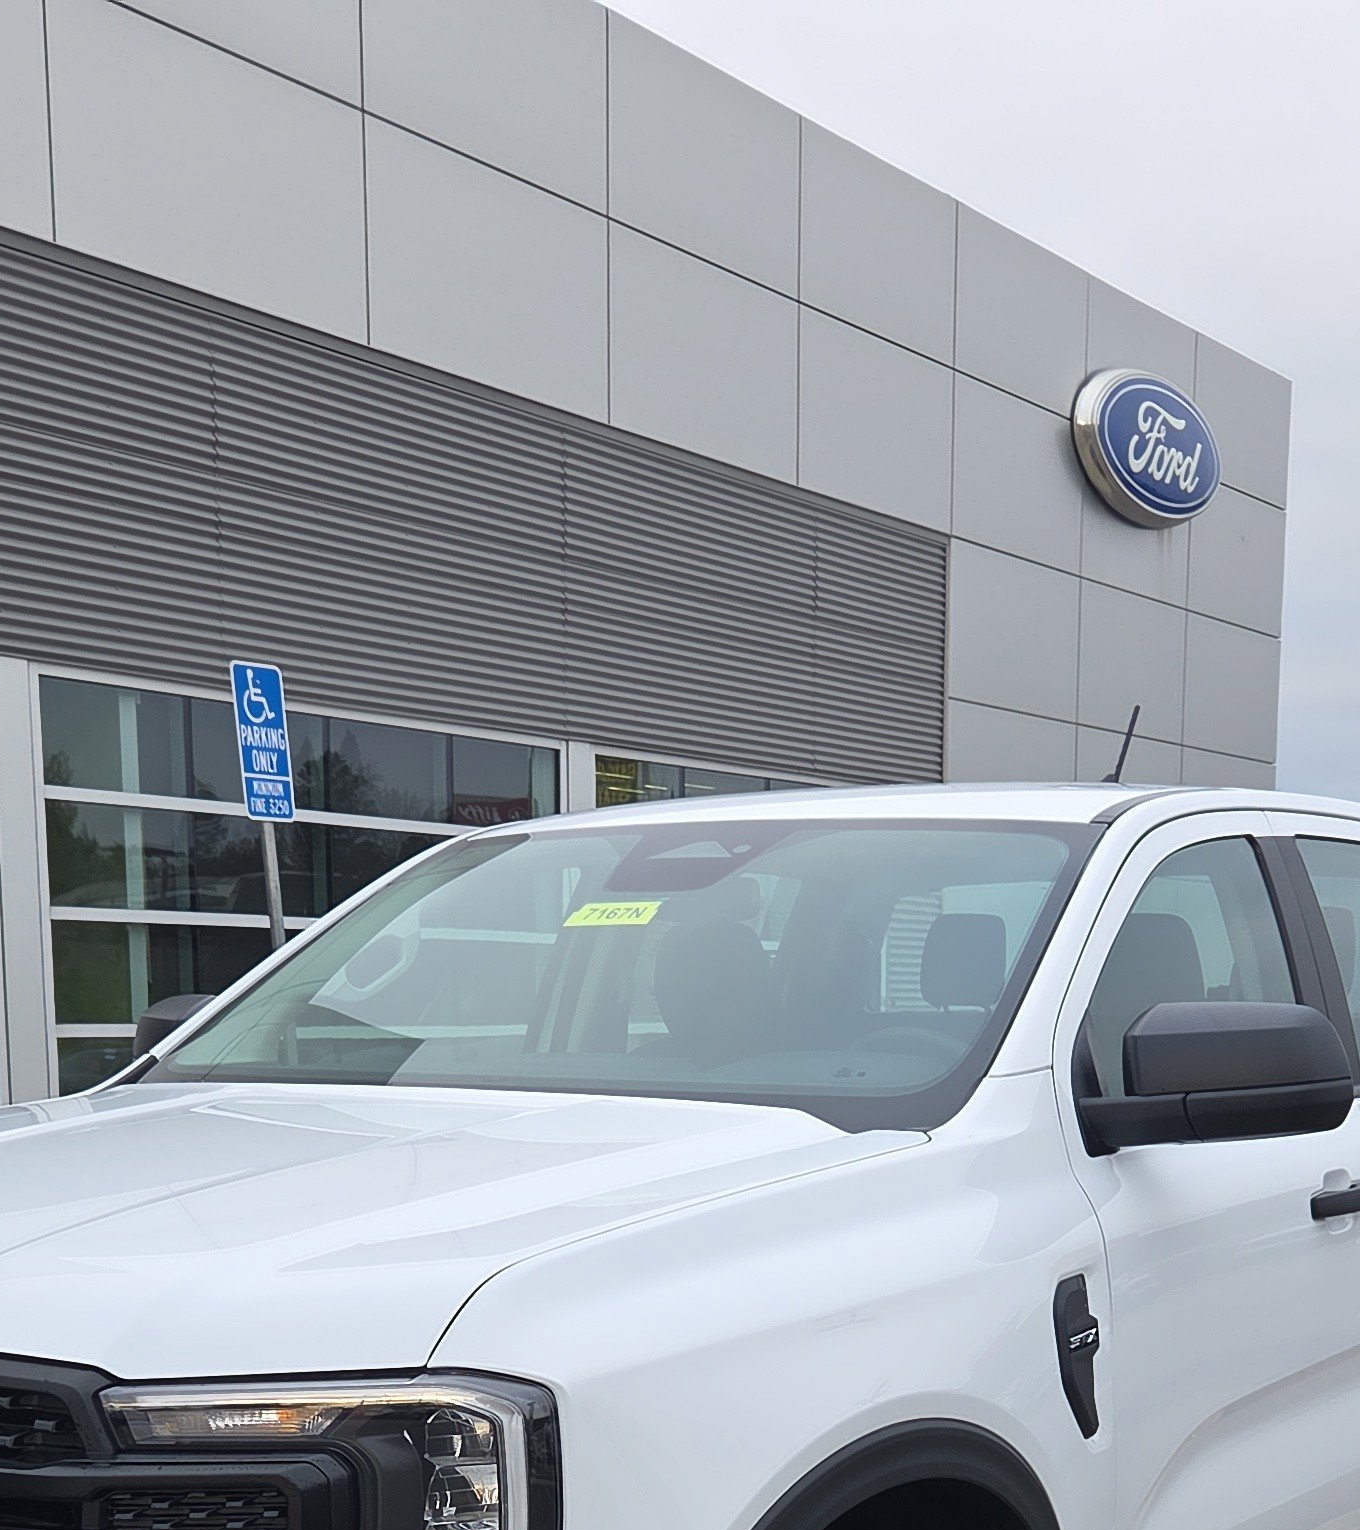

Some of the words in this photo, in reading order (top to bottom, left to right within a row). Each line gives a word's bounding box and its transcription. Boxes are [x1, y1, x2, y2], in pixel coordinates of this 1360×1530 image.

[1128, 401, 1202, 493] Ford
[240, 724, 286, 750] PARKING
[252, 750, 278, 773] ONLY
[251, 797, 266, 814] FINE
[269, 798, 290, 816] $250
[583, 906, 649, 921] 7167N
